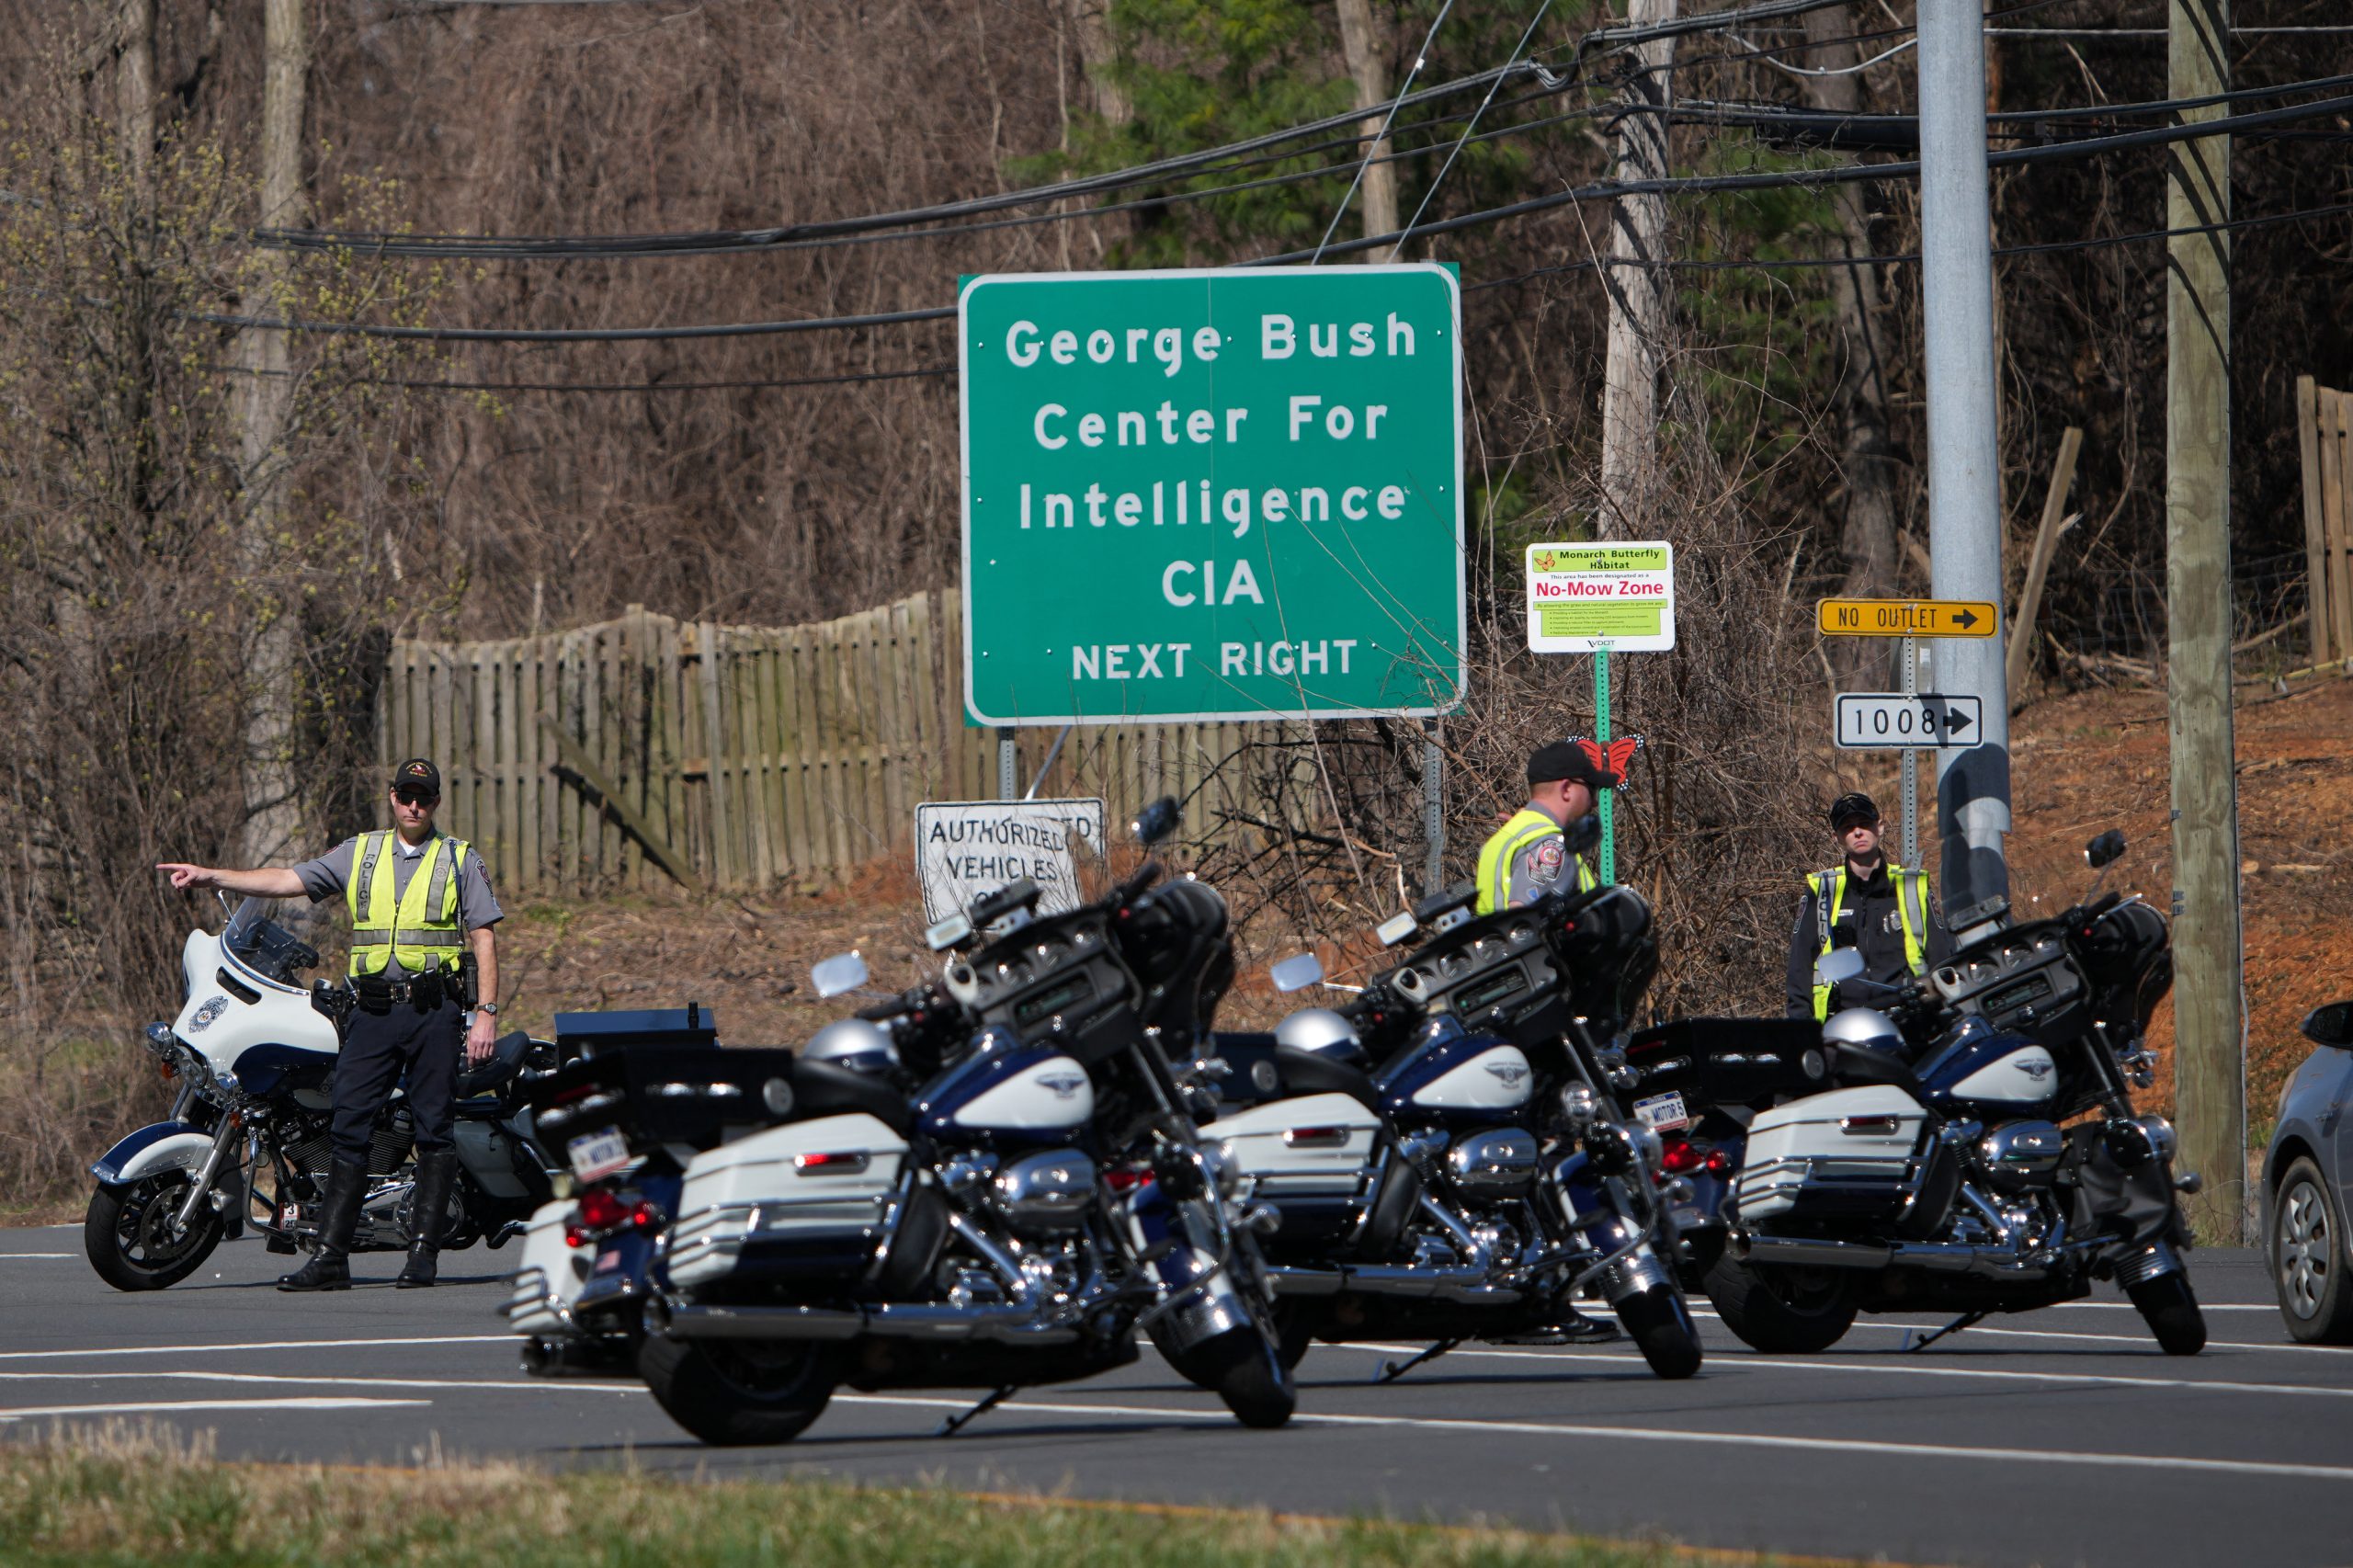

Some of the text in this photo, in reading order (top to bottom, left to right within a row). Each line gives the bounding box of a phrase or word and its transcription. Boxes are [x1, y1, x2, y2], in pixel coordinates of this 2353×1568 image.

[1006, 312, 1415, 377] George Bush
[1034, 395, 1388, 449] Center For
[1020, 479, 1405, 539] Intelligence
[1560, 550, 1659, 559] Monarch Butterfly
[1163, 559, 1264, 607] CIA
[1536, 581, 1664, 597] No-Mow Zone
[1838, 607, 1938, 629] NO OUTLET
[1073, 640, 1358, 680] NEXT RIGHT
[1856, 709, 1936, 734] 1008
[929, 818, 1064, 852] AUTHORIZED
[947, 856, 1059, 881] VEHICLES
[1652, 1101, 1685, 1122] MOTOR 5
